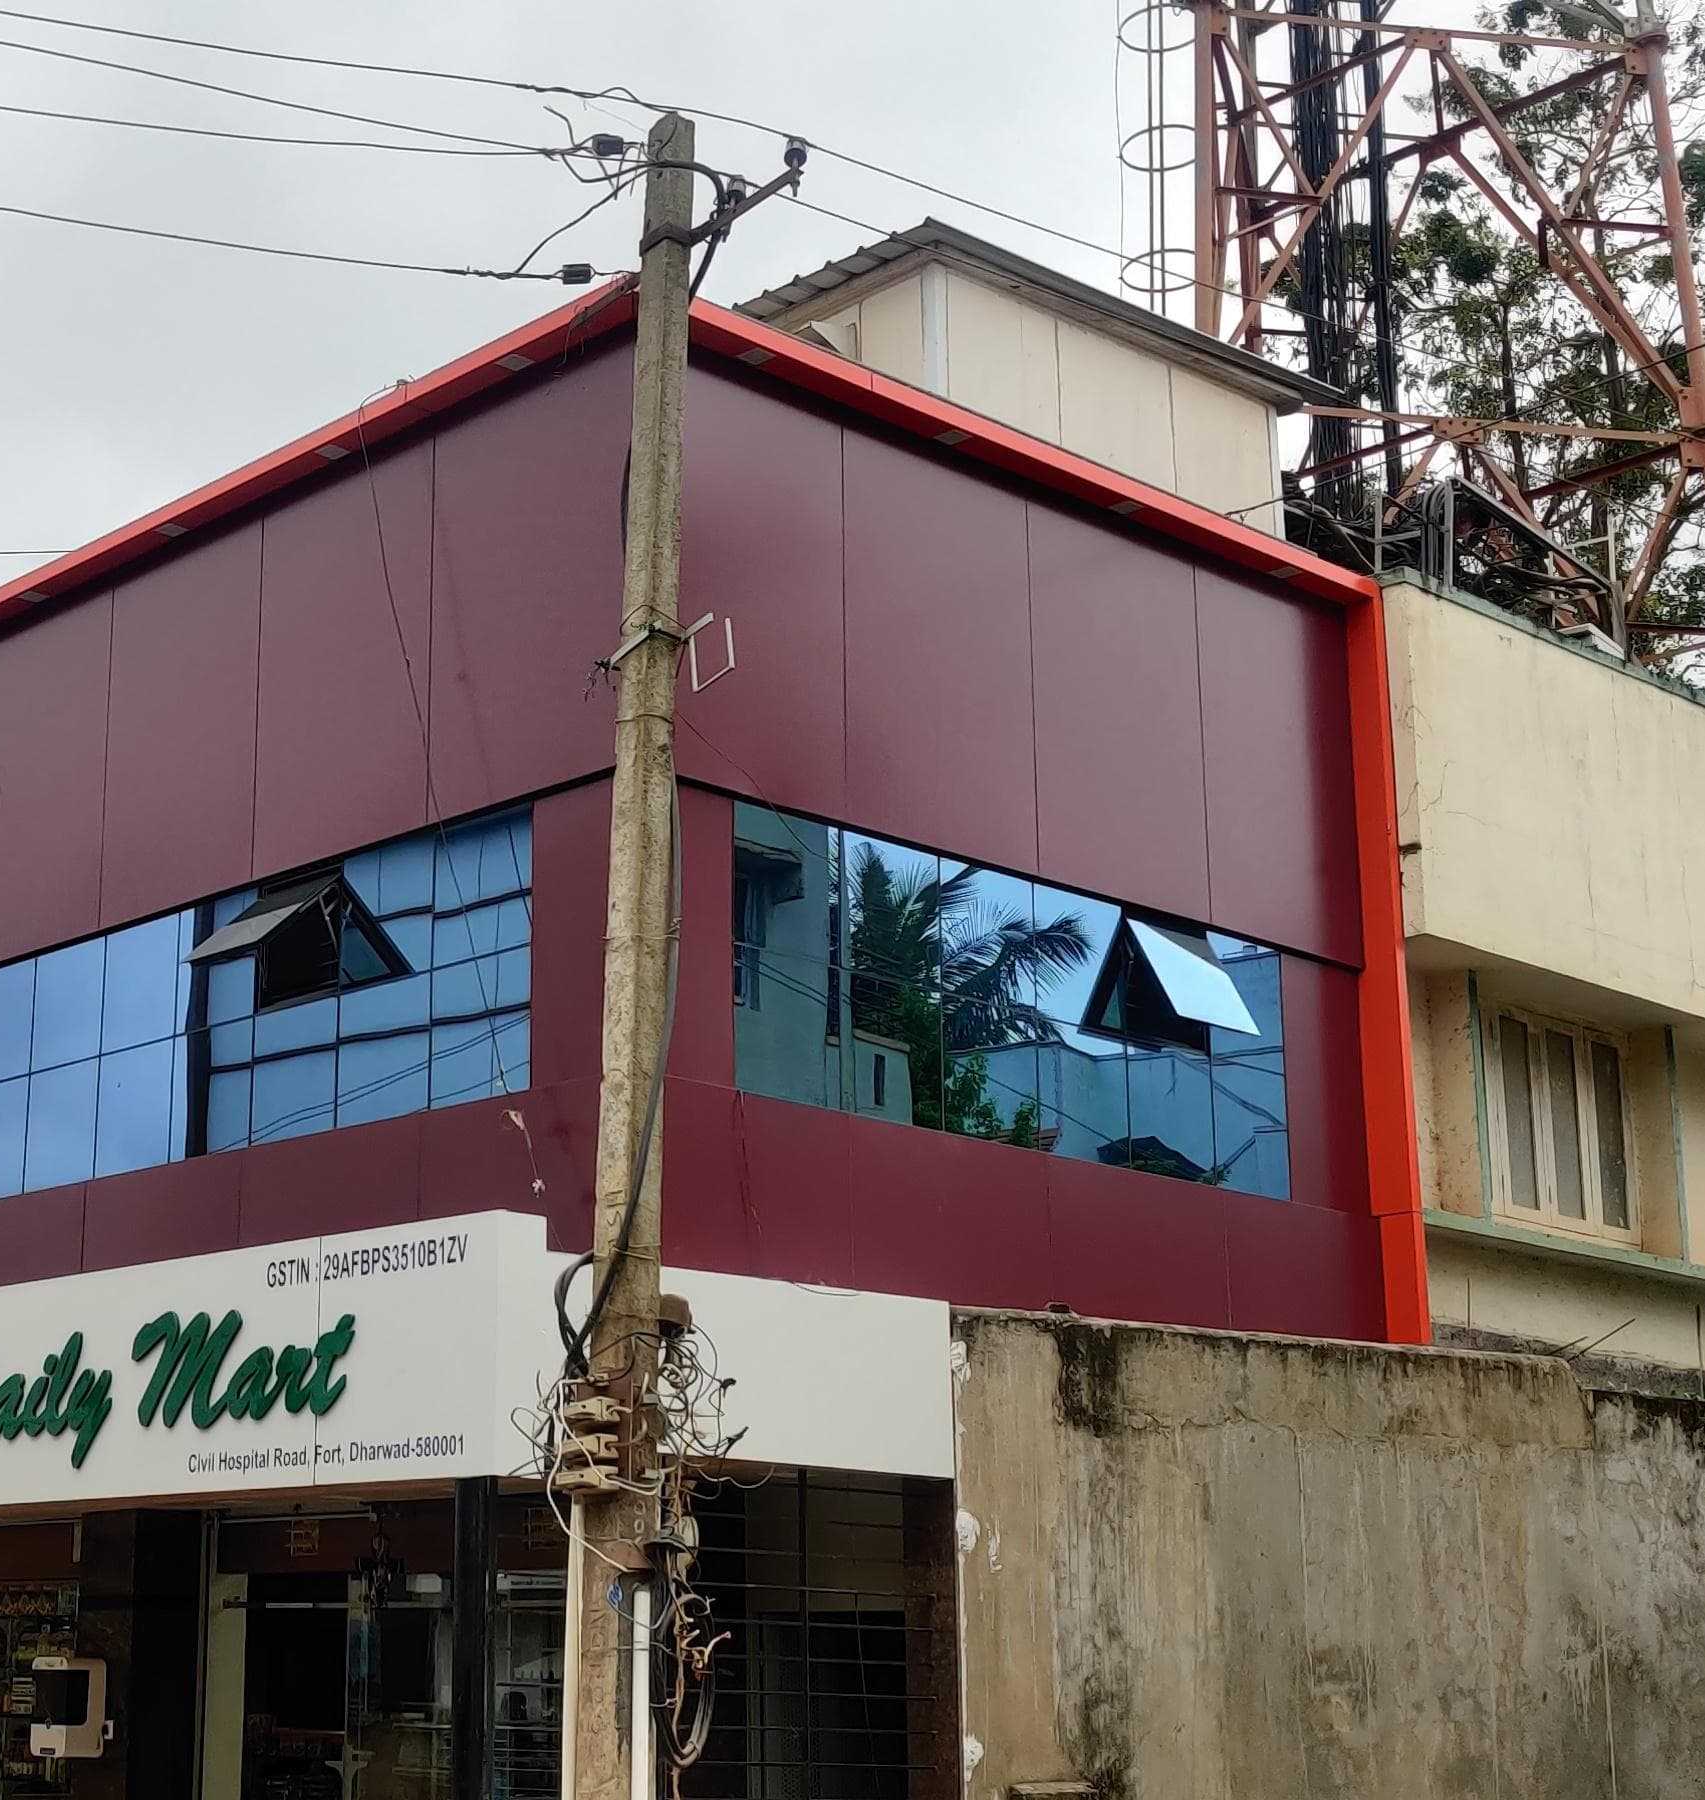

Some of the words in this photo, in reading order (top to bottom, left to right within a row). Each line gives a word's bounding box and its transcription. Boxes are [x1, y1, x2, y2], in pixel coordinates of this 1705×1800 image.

[266, 1256, 310, 1288] GSTIN
[323, 1233, 470, 1281] 29AFBPS3510B1ZV
[131, 1309, 356, 1429] Mart
[187, 1451, 216, 1473] Civil
[218, 1447, 270, 1474] Hospital
[273, 1444, 310, 1469] Road,
[315, 1443, 345, 1467] Fort,
[349, 1434, 465, 1462] Dharwad-580001
